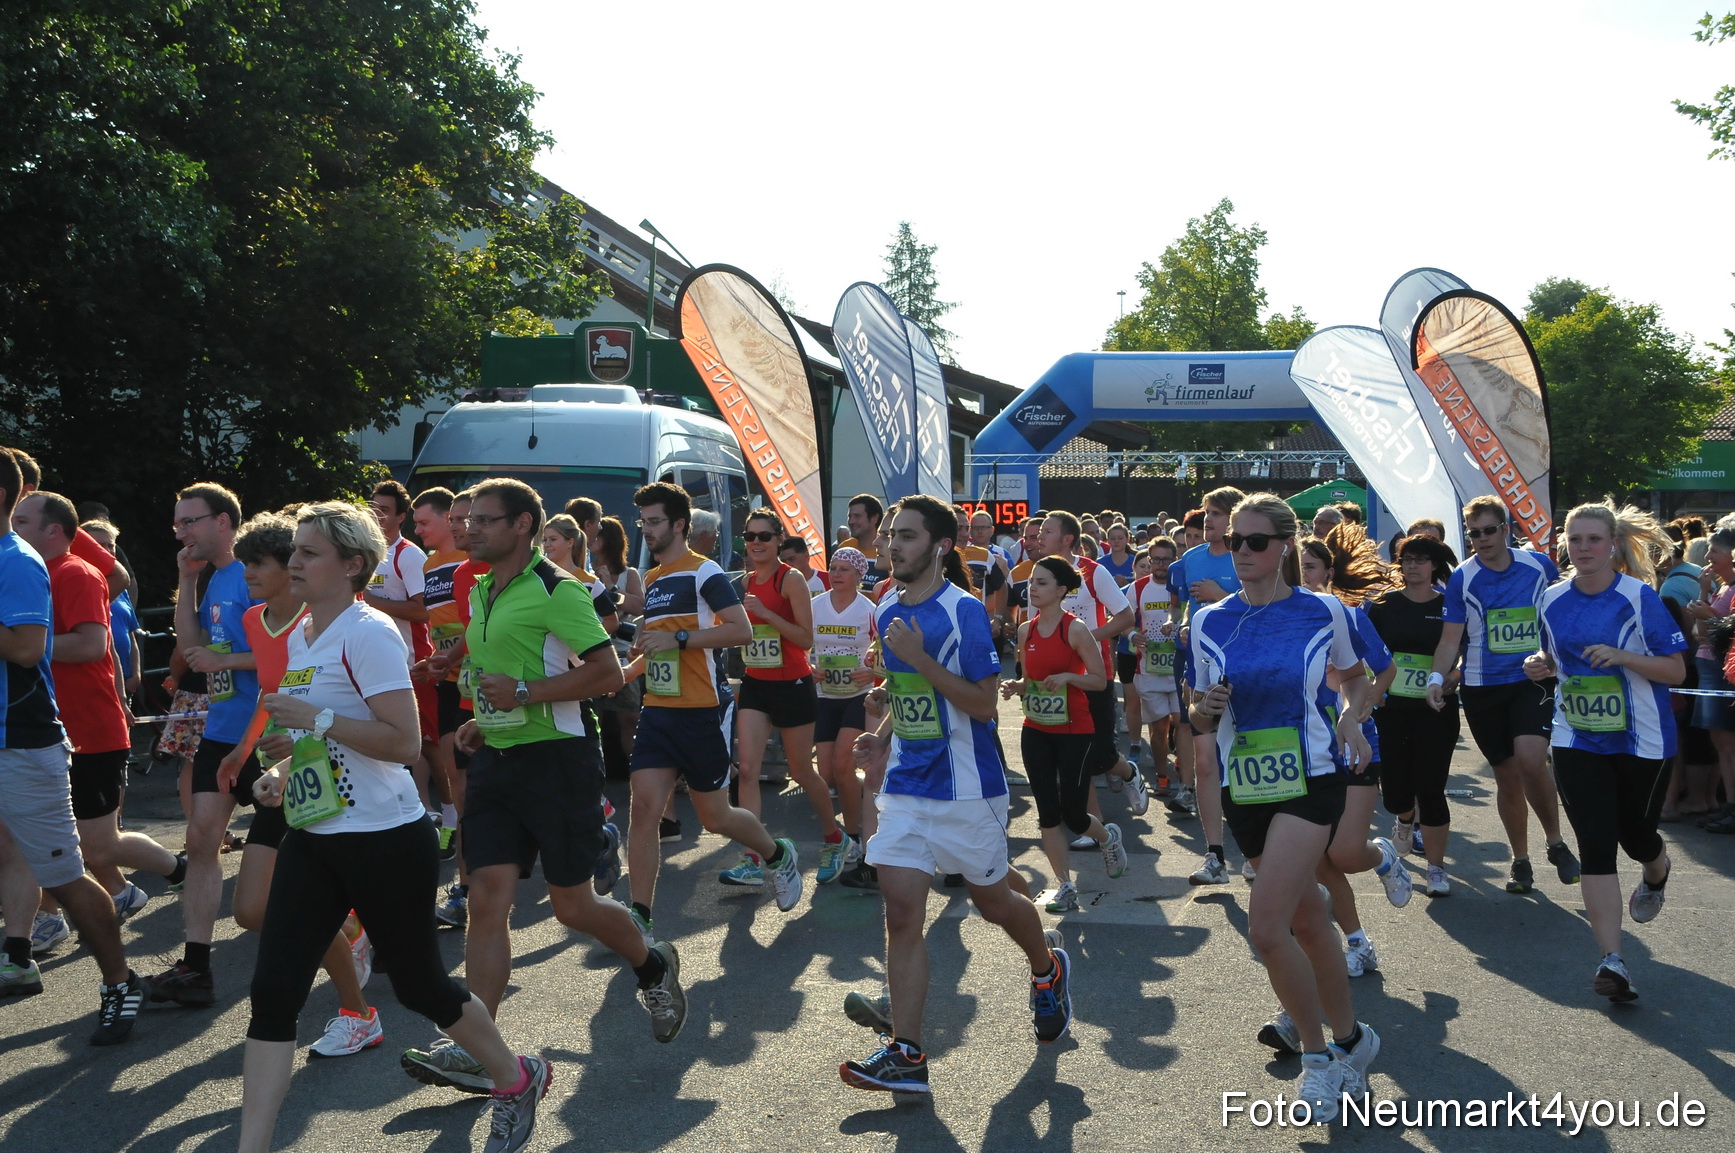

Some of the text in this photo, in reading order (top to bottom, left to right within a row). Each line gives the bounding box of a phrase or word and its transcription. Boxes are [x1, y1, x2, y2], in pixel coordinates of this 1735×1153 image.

[1175, 384, 1256, 400] firmenlauf
[1024, 412, 1067, 421] Fischer
[425, 581, 454, 594] Fischer
[646, 593, 675, 607] Fischer
[818, 626, 853, 634] ONLINE
[1490, 622, 1537, 642] 1044
[745, 639, 780, 657] 1315
[1150, 653, 1174, 667] 908
[281, 667, 312, 685] NLINE
[647, 661, 672, 683] 403
[824, 669, 852, 685] 905
[1404, 669, 1427, 687] 78
[890, 693, 936, 723] 1032
[1023, 694, 1065, 715] 1322
[1565, 694, 1622, 717] 1040
[1230, 752, 1299, 786] 1038
[286, 766, 323, 810] 909
